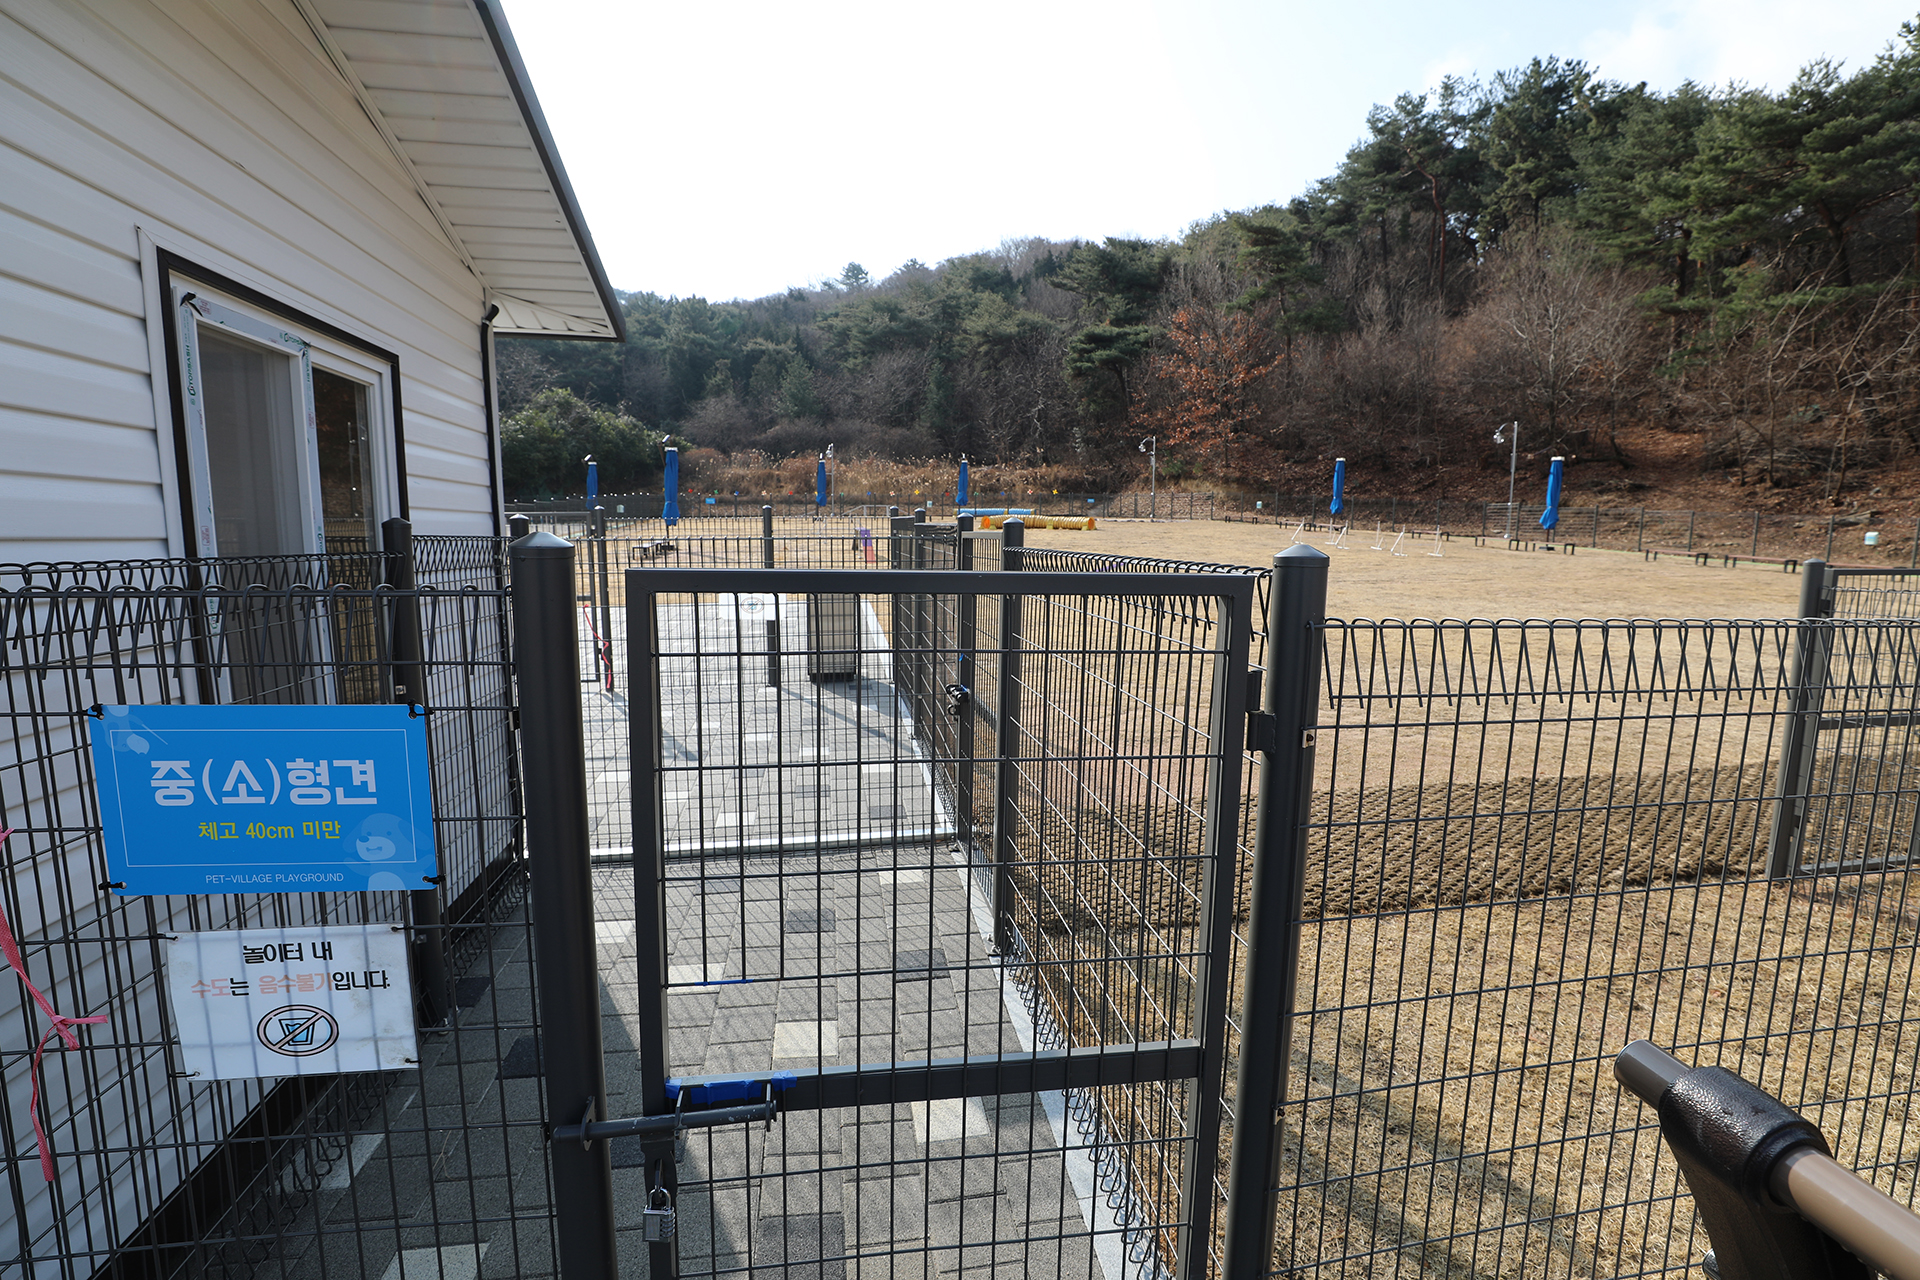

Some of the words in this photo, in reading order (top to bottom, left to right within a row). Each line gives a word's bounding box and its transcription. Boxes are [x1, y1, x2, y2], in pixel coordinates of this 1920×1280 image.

[150, 758, 377, 807] 중(소)형견
[198, 821, 239, 840] 체고
[245, 822, 294, 840] 40cm
[302, 821, 341, 840] 미만
[205, 873, 273, 884] PET-VILLAGE
[275, 873, 344, 883] PLAYGROUND
[242, 942, 303, 964] 놀이터
[311, 941, 333, 961] 내
[190, 977, 249, 999] 수도는
[258, 969, 391, 995] 음수불가입니다.
